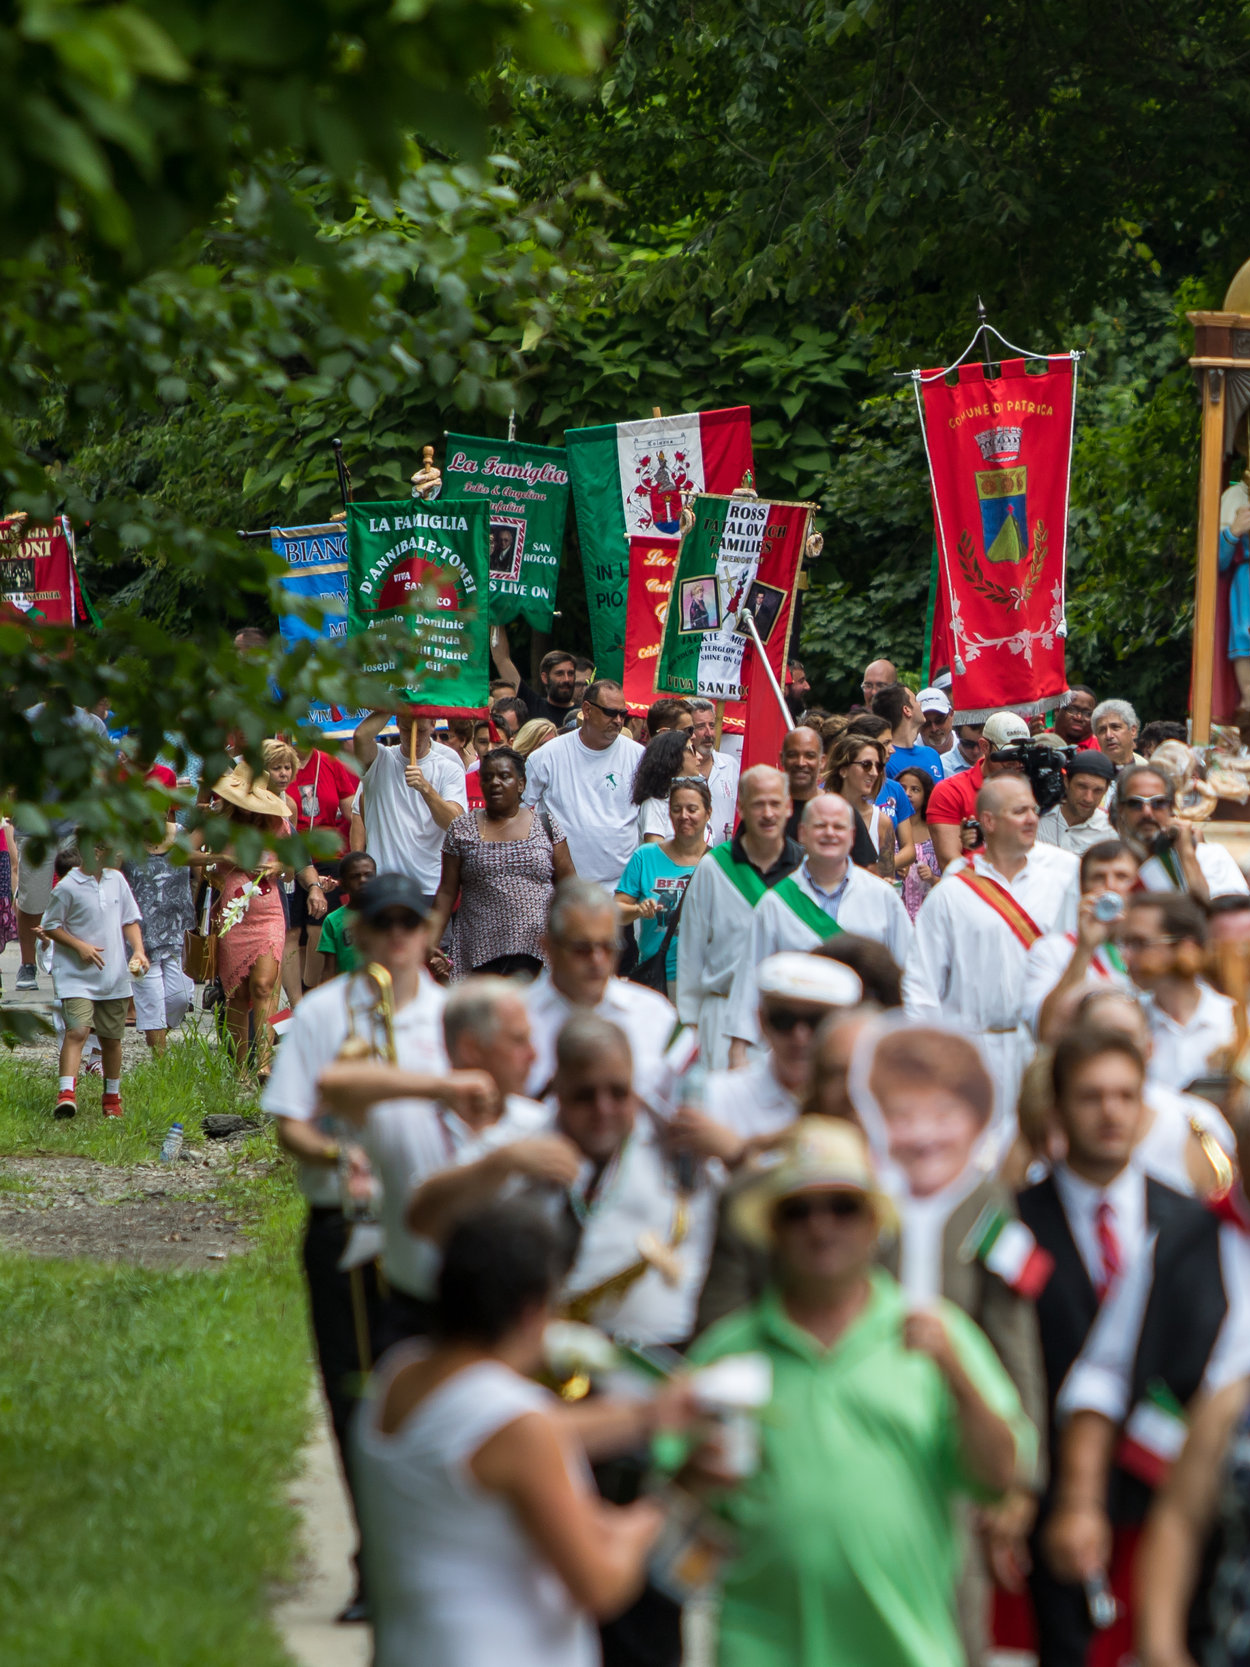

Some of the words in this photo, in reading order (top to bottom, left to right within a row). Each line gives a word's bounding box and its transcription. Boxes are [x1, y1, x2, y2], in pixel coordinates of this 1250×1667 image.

[948, 403, 990, 429] COMUNE
[1007, 399, 1054, 416] PATRICA
[447, 452, 478, 473] La
[481, 456, 568, 486] Famiglia
[463, 481, 490, 494] Felix
[491, 485, 501, 496] &
[502, 486, 547, 501] Angelina
[729, 505, 767, 521] ROSS
[369, 517, 391, 533] LA
[394, 513, 469, 531] FAMIGLIA
[703, 518, 787, 539] TATALOVICH
[532, 542, 551, 553] SAN
[709, 535, 774, 554] FAMILIES
[523, 552, 557, 566] ROCCO
[643, 549, 671, 566] La
[393, 571, 411, 583] VIVA
[596, 564, 613, 581] IN
[404, 582, 424, 591] SAN
[500, 581, 528, 597] LIVE
[531, 585, 550, 600] ON
[596, 590, 624, 609] PIO
[415, 613, 465, 630] Dominic
[682, 632, 721, 645] JACKIE
[433, 648, 469, 661] Diane
[700, 653, 721, 662] SHINE
[723, 655, 733, 664] ON
[361, 660, 396, 673] Joseph
[667, 674, 695, 691] VIVA
[698, 681, 724, 695] SAN
